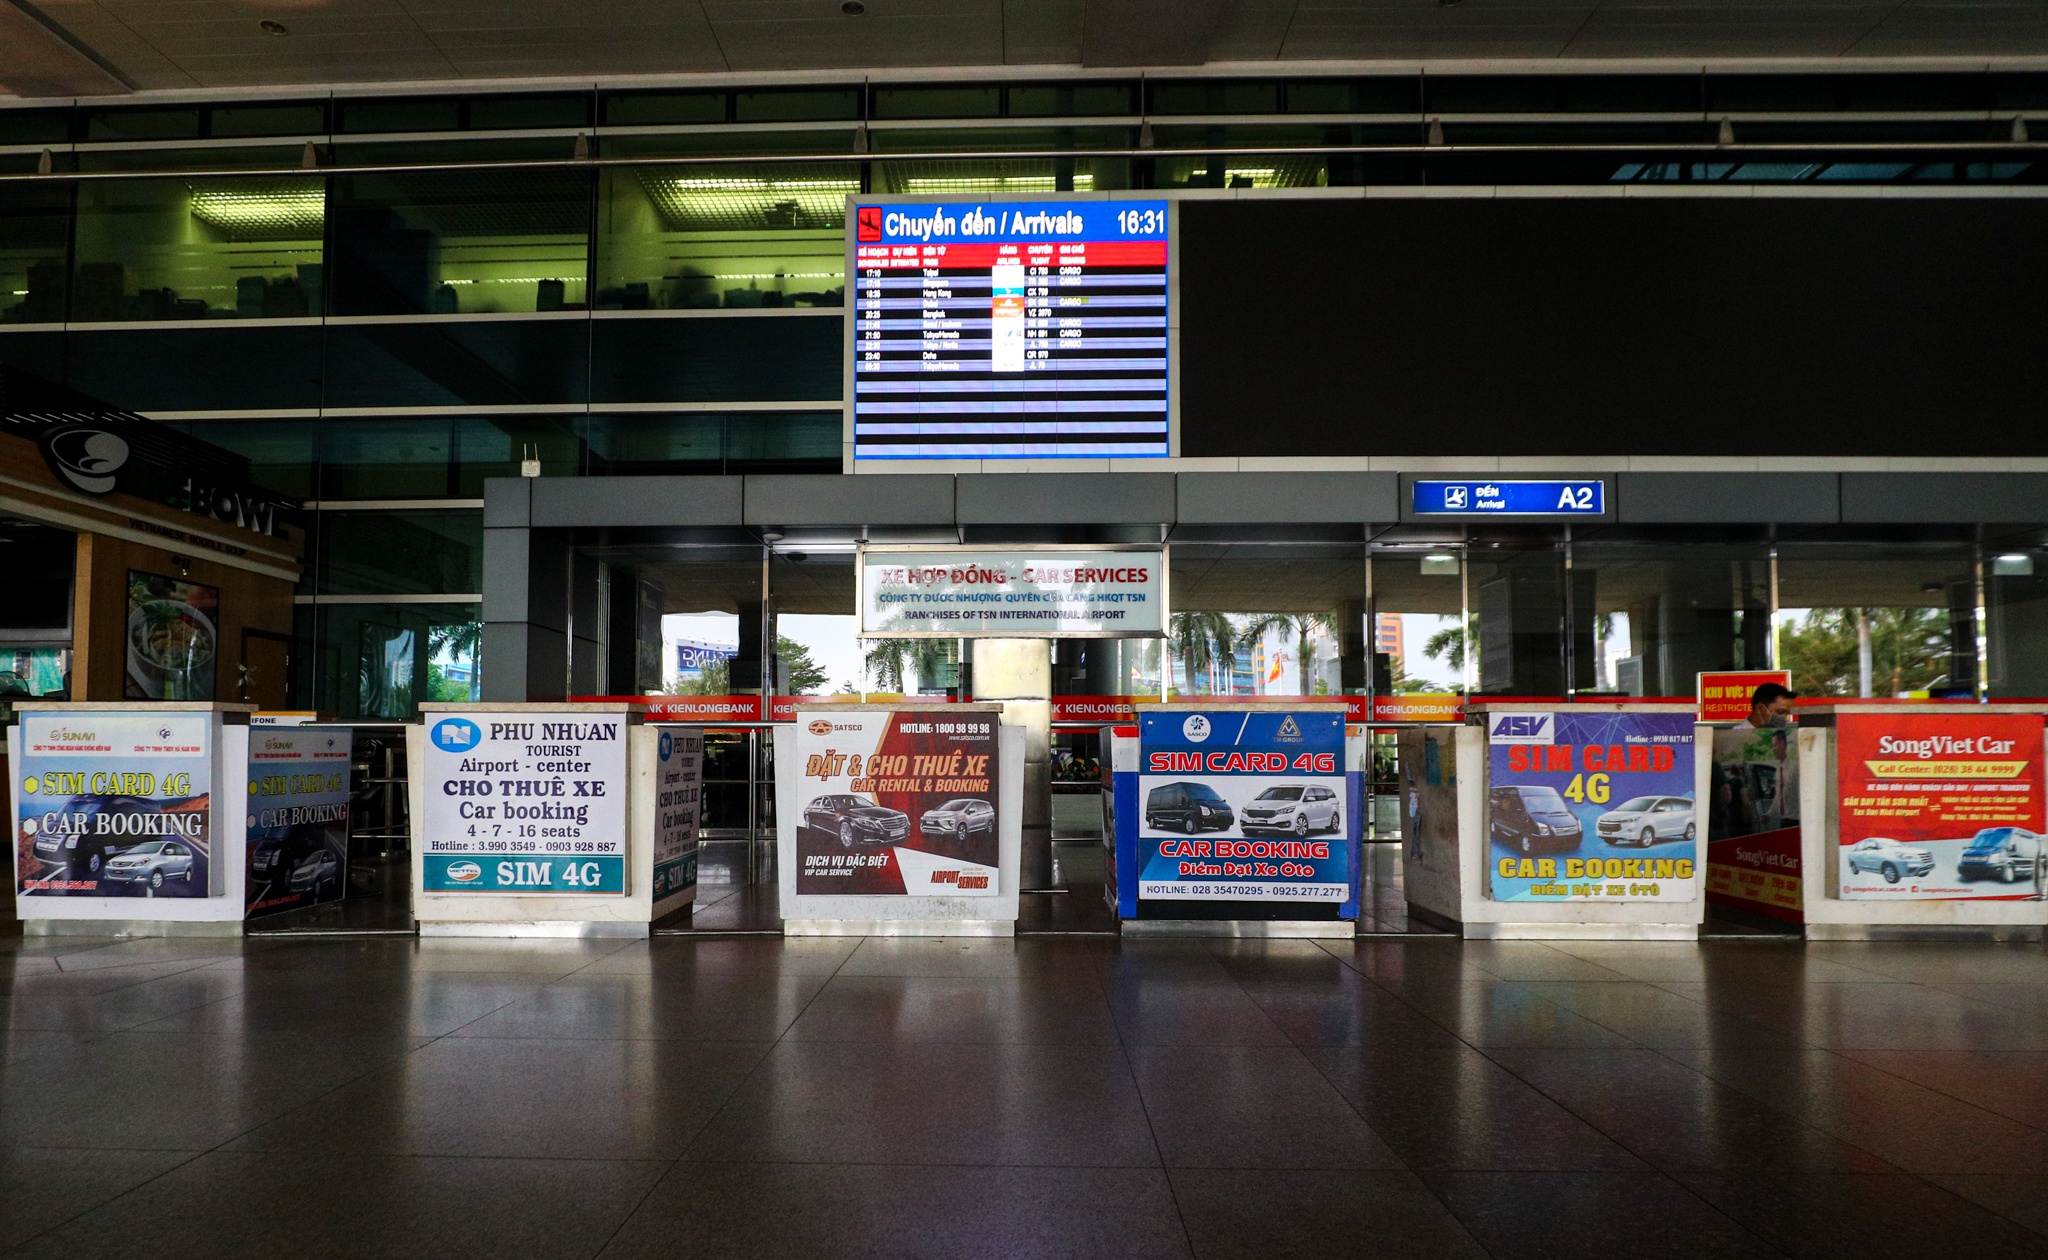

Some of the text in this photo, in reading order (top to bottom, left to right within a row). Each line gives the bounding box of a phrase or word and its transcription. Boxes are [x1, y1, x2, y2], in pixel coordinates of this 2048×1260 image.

[885, 207, 956, 241] Chuyến
[961, 207, 995, 235] đến
[1011, 210, 1084, 234] Arrivals
[1117, 210, 1165, 234] 16:31
[1060, 267, 1081, 275] CARGO
[1060, 277, 1082, 286] CARGO
[938, 290, 951, 299] Kong
[1060, 298, 1082, 306] CARGO
[1028, 309, 1037, 317] VZ
[1060, 319, 1082, 327] CARGO
[1027, 330, 1081, 338] NH CARGO
[1060, 340, 1082, 348] CARGO
[1476, 484, 1594, 509] ĐẾN A2
[1476, 499, 1506, 509] Arrival
[129, 518, 246, 557] VIETNAMESE NOODLE SOUP
[881, 568, 904, 584] XE
[908, 567, 947, 588] HỢP
[951, 563, 1007, 584] ĐỒNG
[1022, 567, 1060, 584] CAR
[1063, 567, 1149, 584] SERVICES
[879, 592, 908, 603] CÔNG
[909, 593, 923, 603] TY
[1097, 593, 1126, 603] HKQT
[1126, 593, 1146, 602] TSN
[963, 611, 976, 619] OF
[978, 611, 997, 619] TSN
[1082, 611, 1126, 619] AIRPORT
[1705, 684, 1743, 700] KHU VỰC
[667, 704, 754, 713] KIENLONGBANK
[1376, 705, 1460, 714] KIENLONGBANK
[1705, 704, 1753, 712] RESTRICTE
[490, 723, 534, 740] PHU
[900, 723, 990, 734] HOTLINE: 1800 98 99 98
[1491, 716, 1550, 736] ASV
[1625, 734, 1693, 743] Hotline 0938 817 817
[526, 745, 582, 757] TOURIST
[1879, 735, 2016, 759] SongViet Car
[459, 758, 518, 776] Airport
[536, 760, 591, 773] center
[806, 749, 989, 782] ĐẶT & CHO THUÊ XE
[1150, 752, 1335, 773] SIM CARD 4G
[1508, 745, 1675, 773] SIM CARD
[1877, 765, 2016, 775] Call Center: (028) 38 44 9999
[43, 772, 190, 797] SIM CARD 4G
[261, 772, 342, 797] SIM CARD 4G
[443, 776, 606, 797] CHO THUÊ XE
[851, 778, 989, 793] CAR RENTAL & BOOKING
[1564, 773, 1611, 804] 4G
[660, 790, 673, 808] CHO
[260, 803, 347, 829] CAR BOOKING
[459, 801, 589, 825] Car booking
[662, 808, 693, 830] Car booking
[42, 812, 202, 837] CAR BOOKING
[467, 825, 477, 837] 4
[492, 825, 501, 837] 7
[519, 824, 536, 837] 16
[541, 826, 580, 838] seats
[431, 840, 616, 852] Hotline 3.990 3549 0903 928 887
[1159, 840, 1330, 859] CAR BOOKING
[805, 853, 889, 868] DỊCH VỤ ĐẶC BIỆT
[1736, 846, 1799, 869] SongViet Car
[497, 861, 602, 887] SIM 4G
[668, 861, 697, 890] SIM 4G
[829, 868, 853, 876] SERVICE
[1254, 862, 1278, 876] Xe
[1498, 857, 1557, 879] CAR
[1565, 857, 1694, 879] BOOKING
[931, 871, 960, 883] AIRPORT
[958, 876, 988, 889] SERVICES
[1147, 886, 1342, 897] HOTLINE: 028 35470295 0925.277.277
[1606, 885, 1627, 896] XE
[1630, 883, 1660, 896] ÔTÔ
